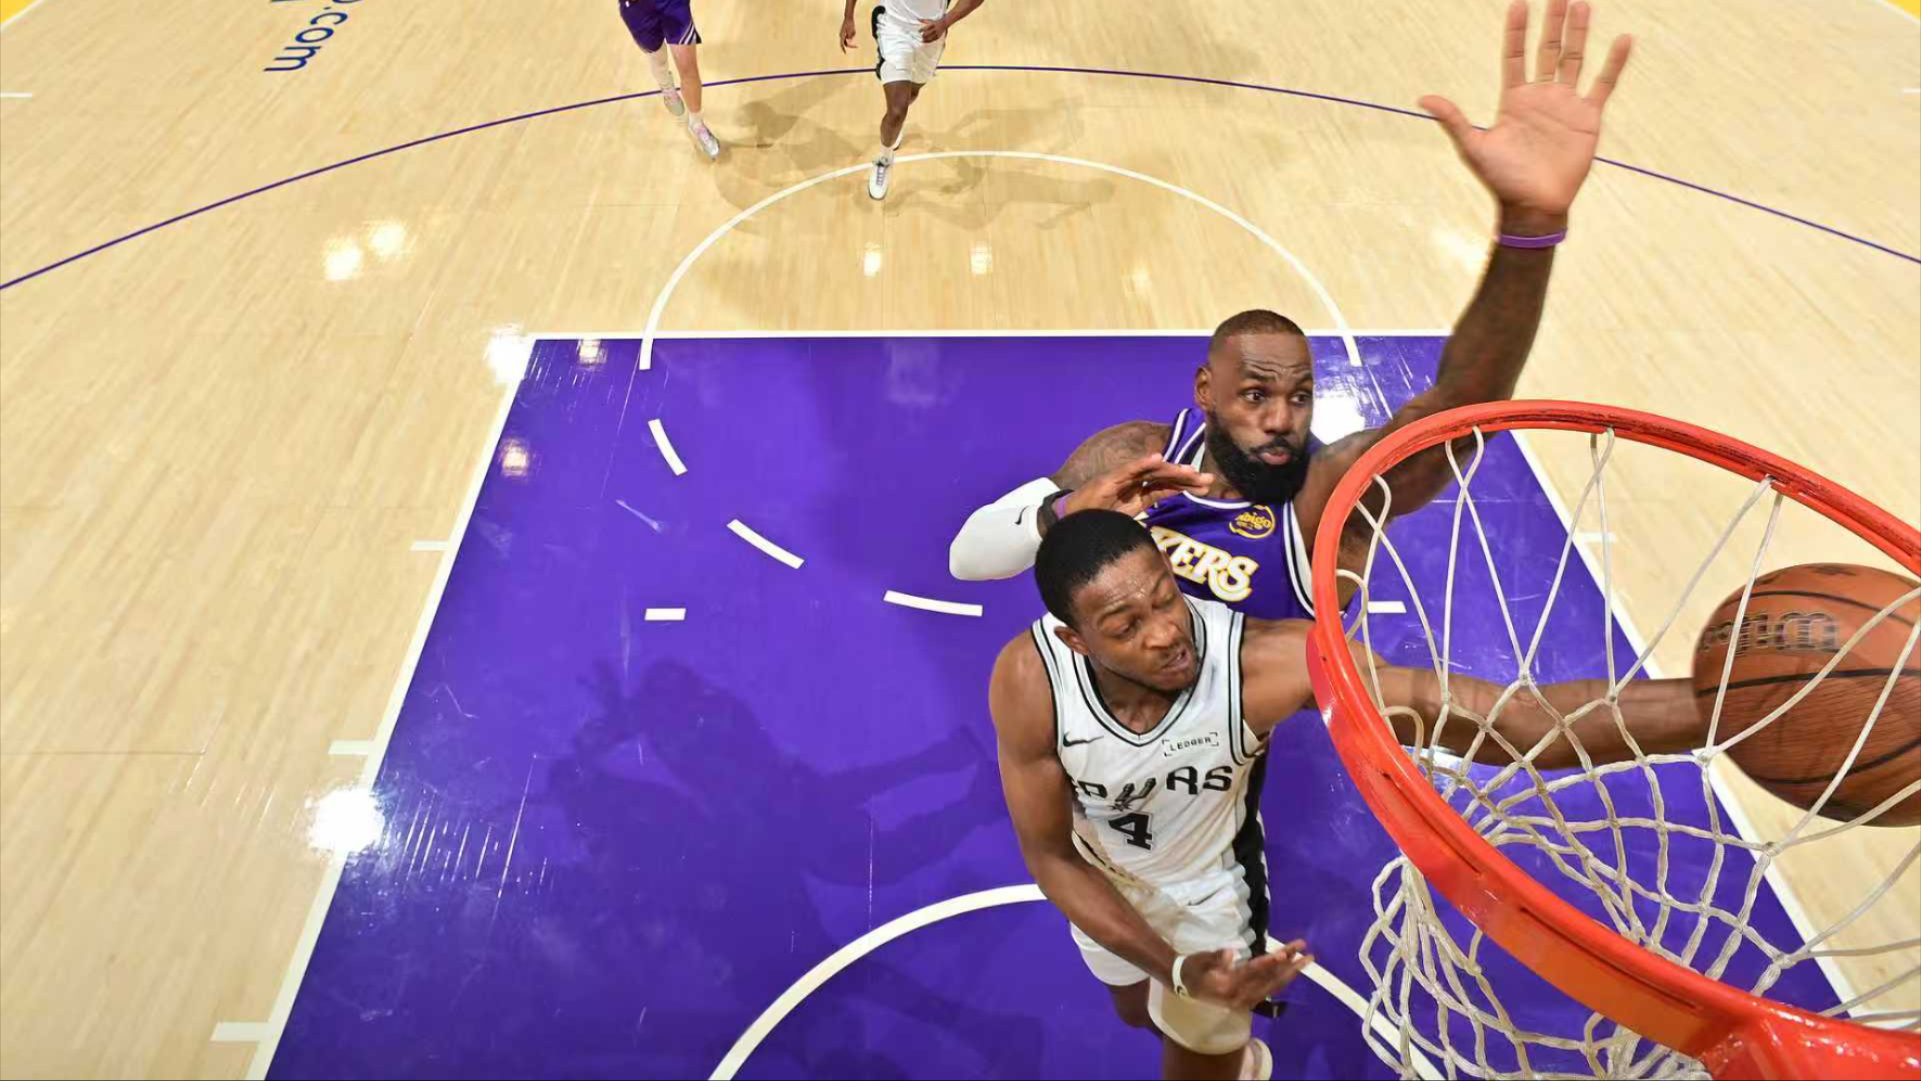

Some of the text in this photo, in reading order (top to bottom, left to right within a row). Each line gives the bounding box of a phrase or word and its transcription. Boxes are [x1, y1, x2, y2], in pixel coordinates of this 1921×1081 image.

[263, 0, 361, 72] .com
[1150, 525, 1260, 602] KERS
[1073, 765, 1234, 812] PURS
[1108, 812, 1153, 850] 4
